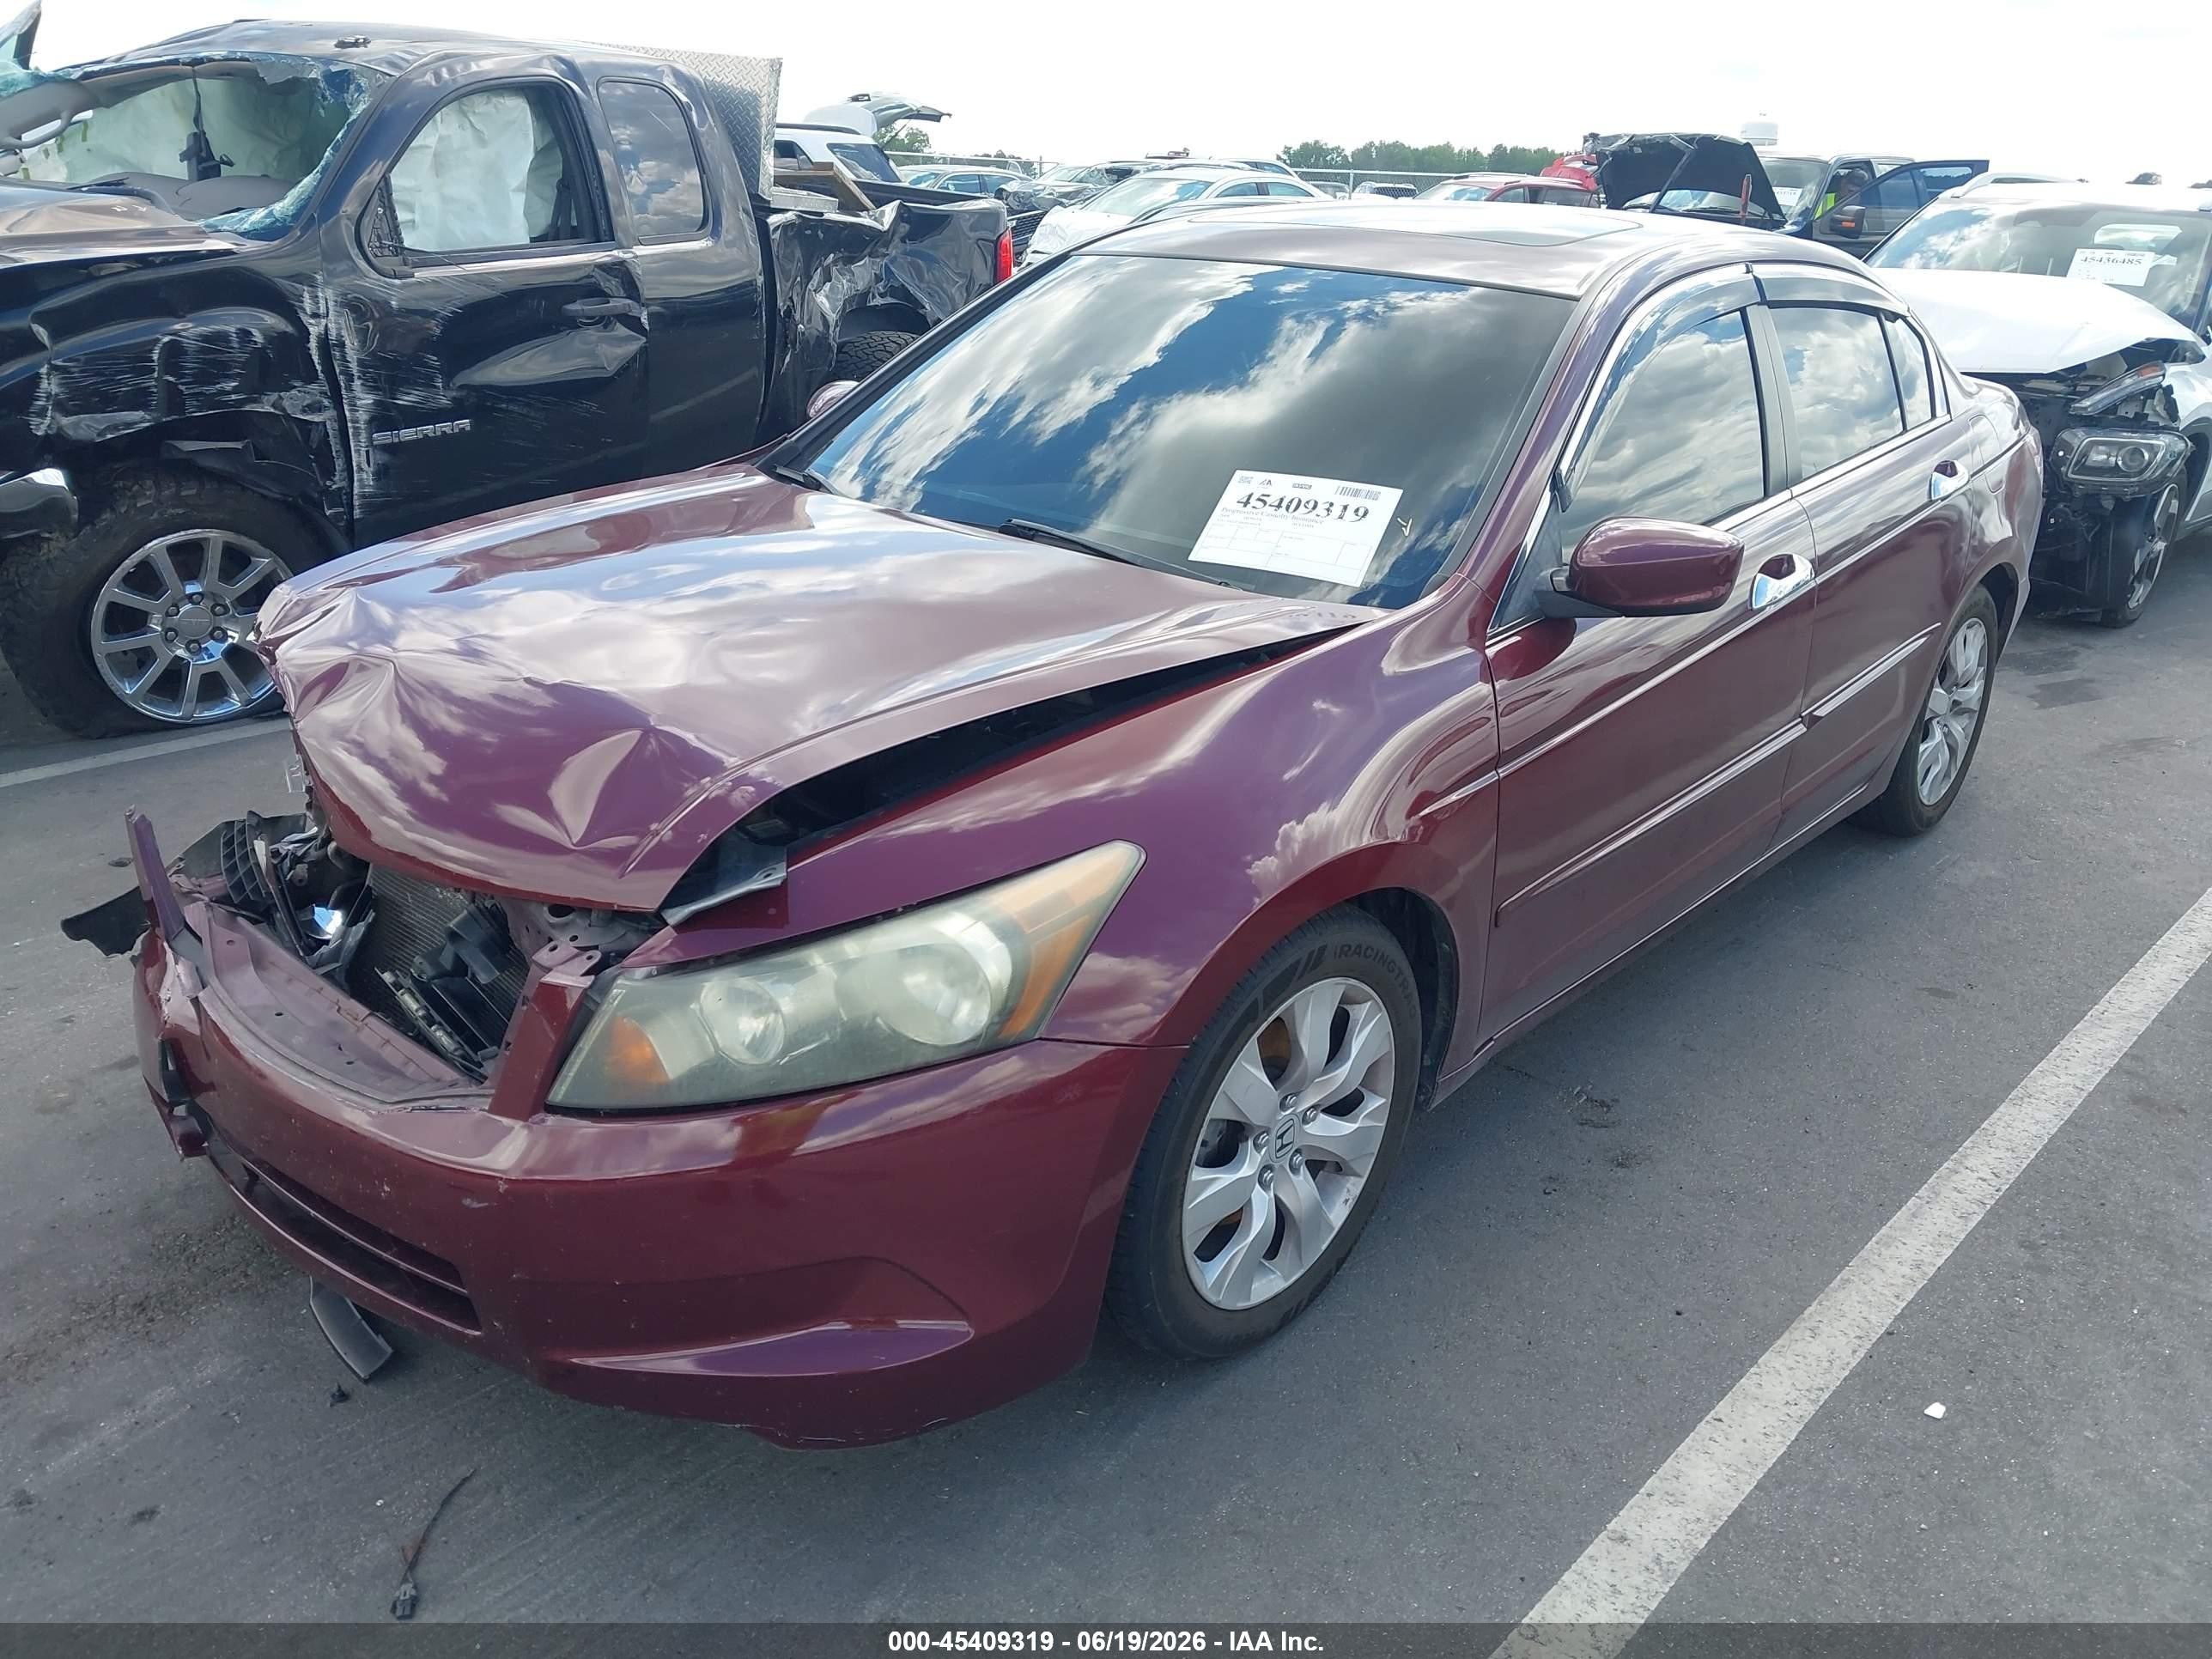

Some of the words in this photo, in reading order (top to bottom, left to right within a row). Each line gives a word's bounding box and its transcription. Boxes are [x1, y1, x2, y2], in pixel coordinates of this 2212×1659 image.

[2081, 256, 2142, 265] 45436485
[372, 419, 471, 445] SIERRA
[1236, 491, 1370, 523] 45409319
